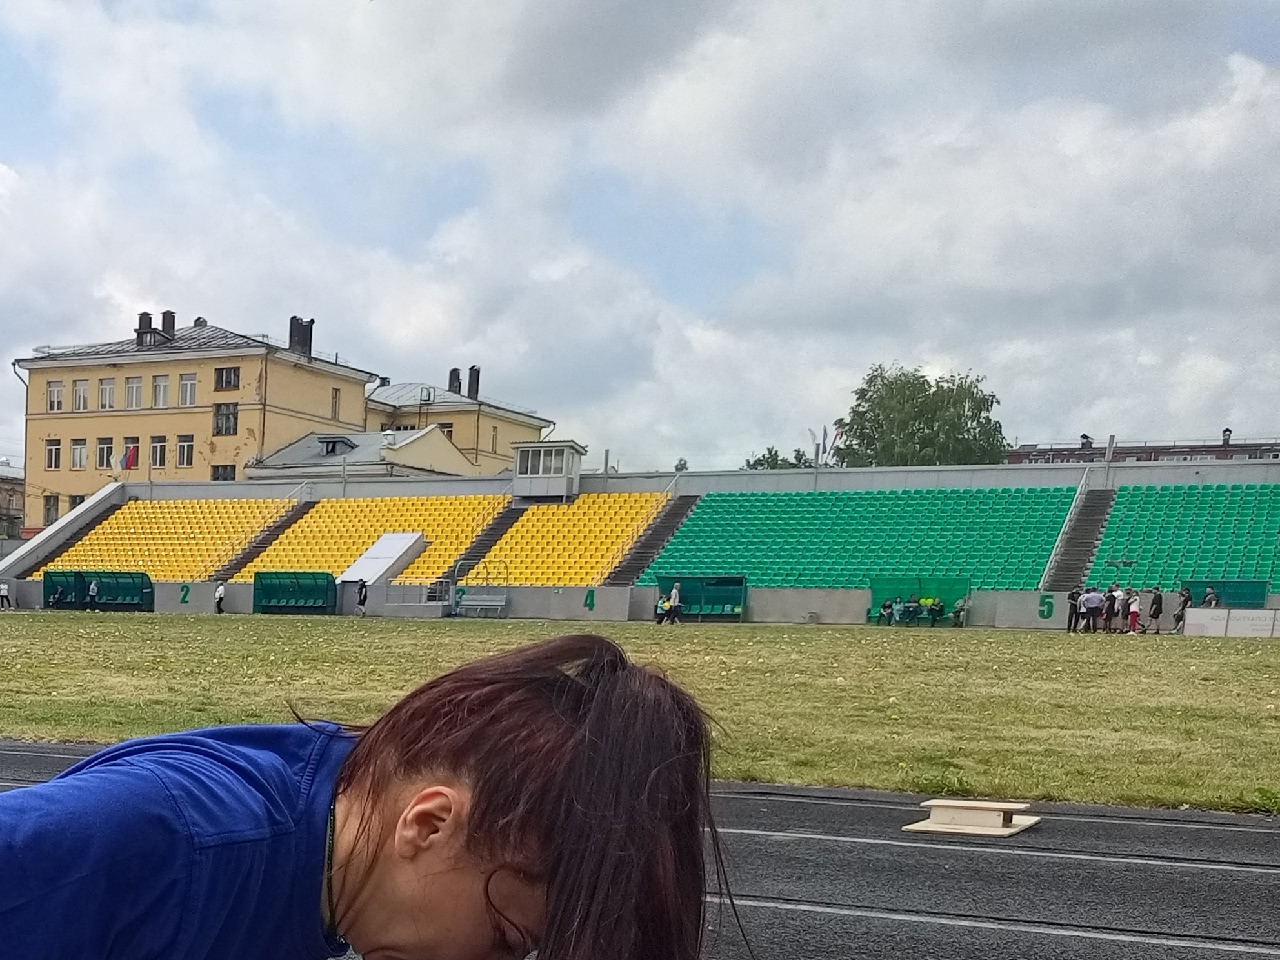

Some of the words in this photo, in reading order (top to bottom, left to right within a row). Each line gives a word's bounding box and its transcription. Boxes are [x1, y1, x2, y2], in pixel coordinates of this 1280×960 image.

[180, 584, 190, 603] 2
[583, 589, 595, 611] 4
[1039, 594, 1054, 619] 5
